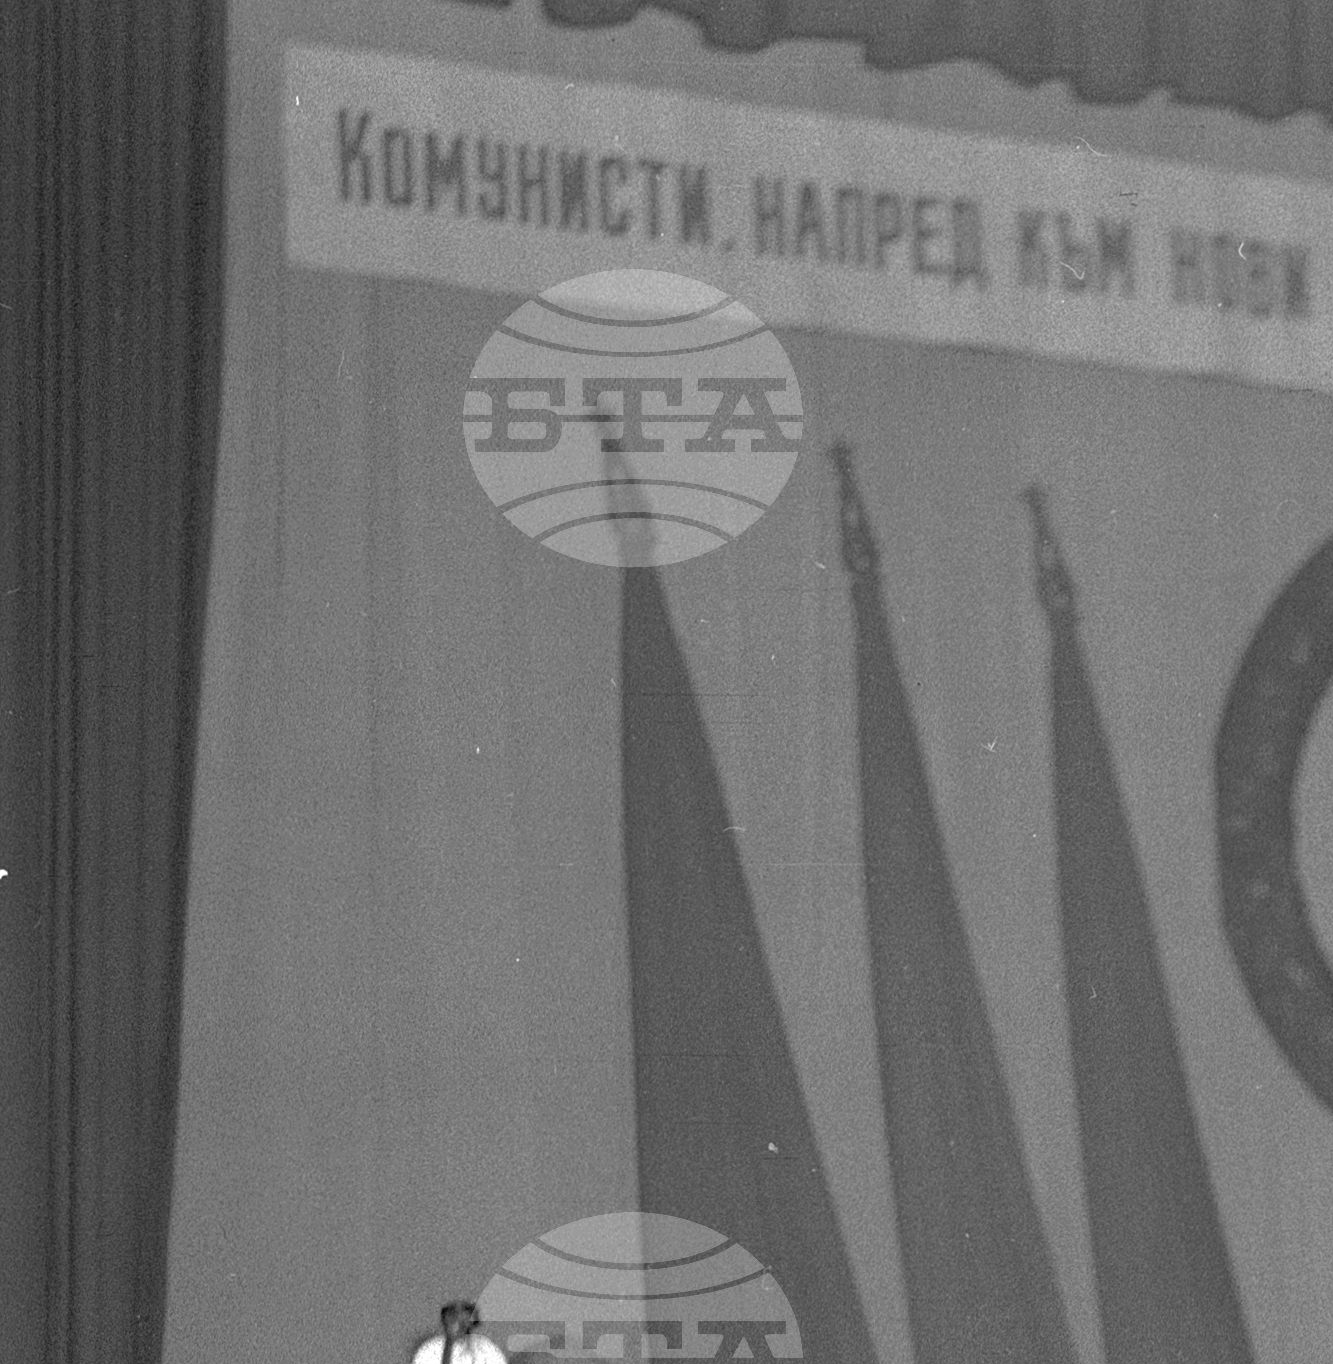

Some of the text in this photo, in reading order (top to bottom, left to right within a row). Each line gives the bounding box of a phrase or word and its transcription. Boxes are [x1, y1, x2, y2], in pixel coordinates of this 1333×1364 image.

[750, 172, 995, 292] НАПРЕД
[1011, 206, 1140, 301] КЪМ
[1167, 224, 1315, 323] НОВИ
